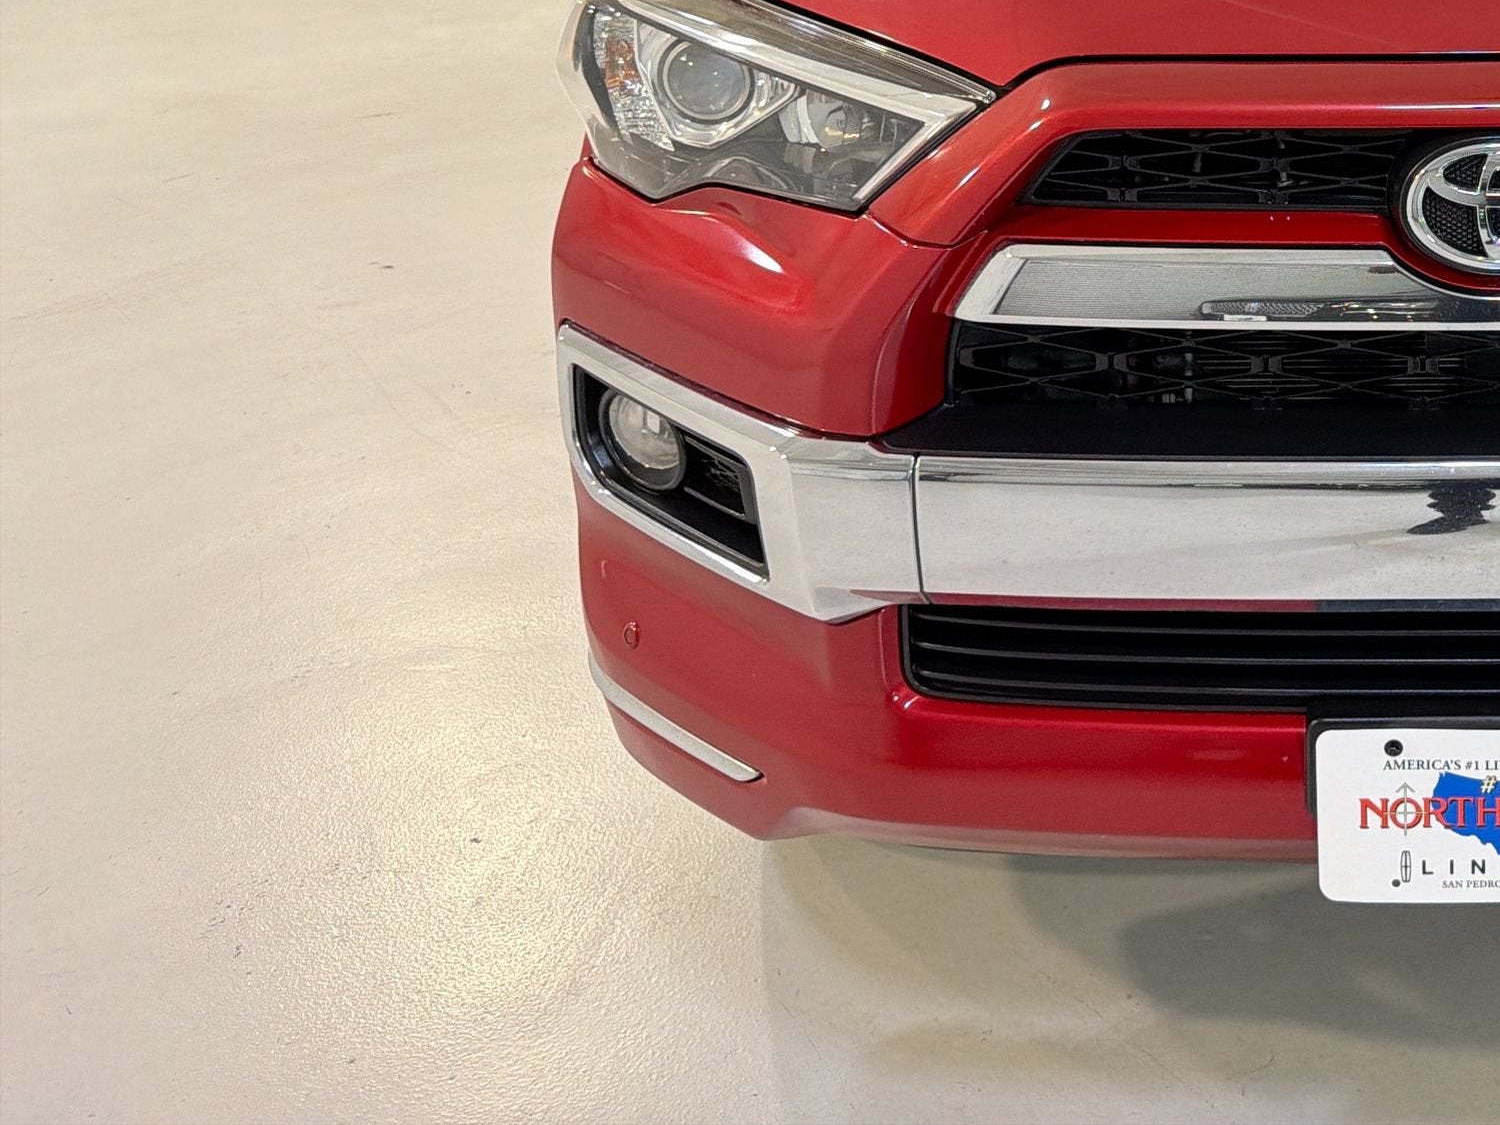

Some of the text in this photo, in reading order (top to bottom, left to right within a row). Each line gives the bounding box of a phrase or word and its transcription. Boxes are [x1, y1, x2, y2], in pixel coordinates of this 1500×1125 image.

[1383, 759, 1462, 771] AMERICA'S
[1464, 760, 1480, 770] #1
[1442, 880, 1463, 888] SAN
